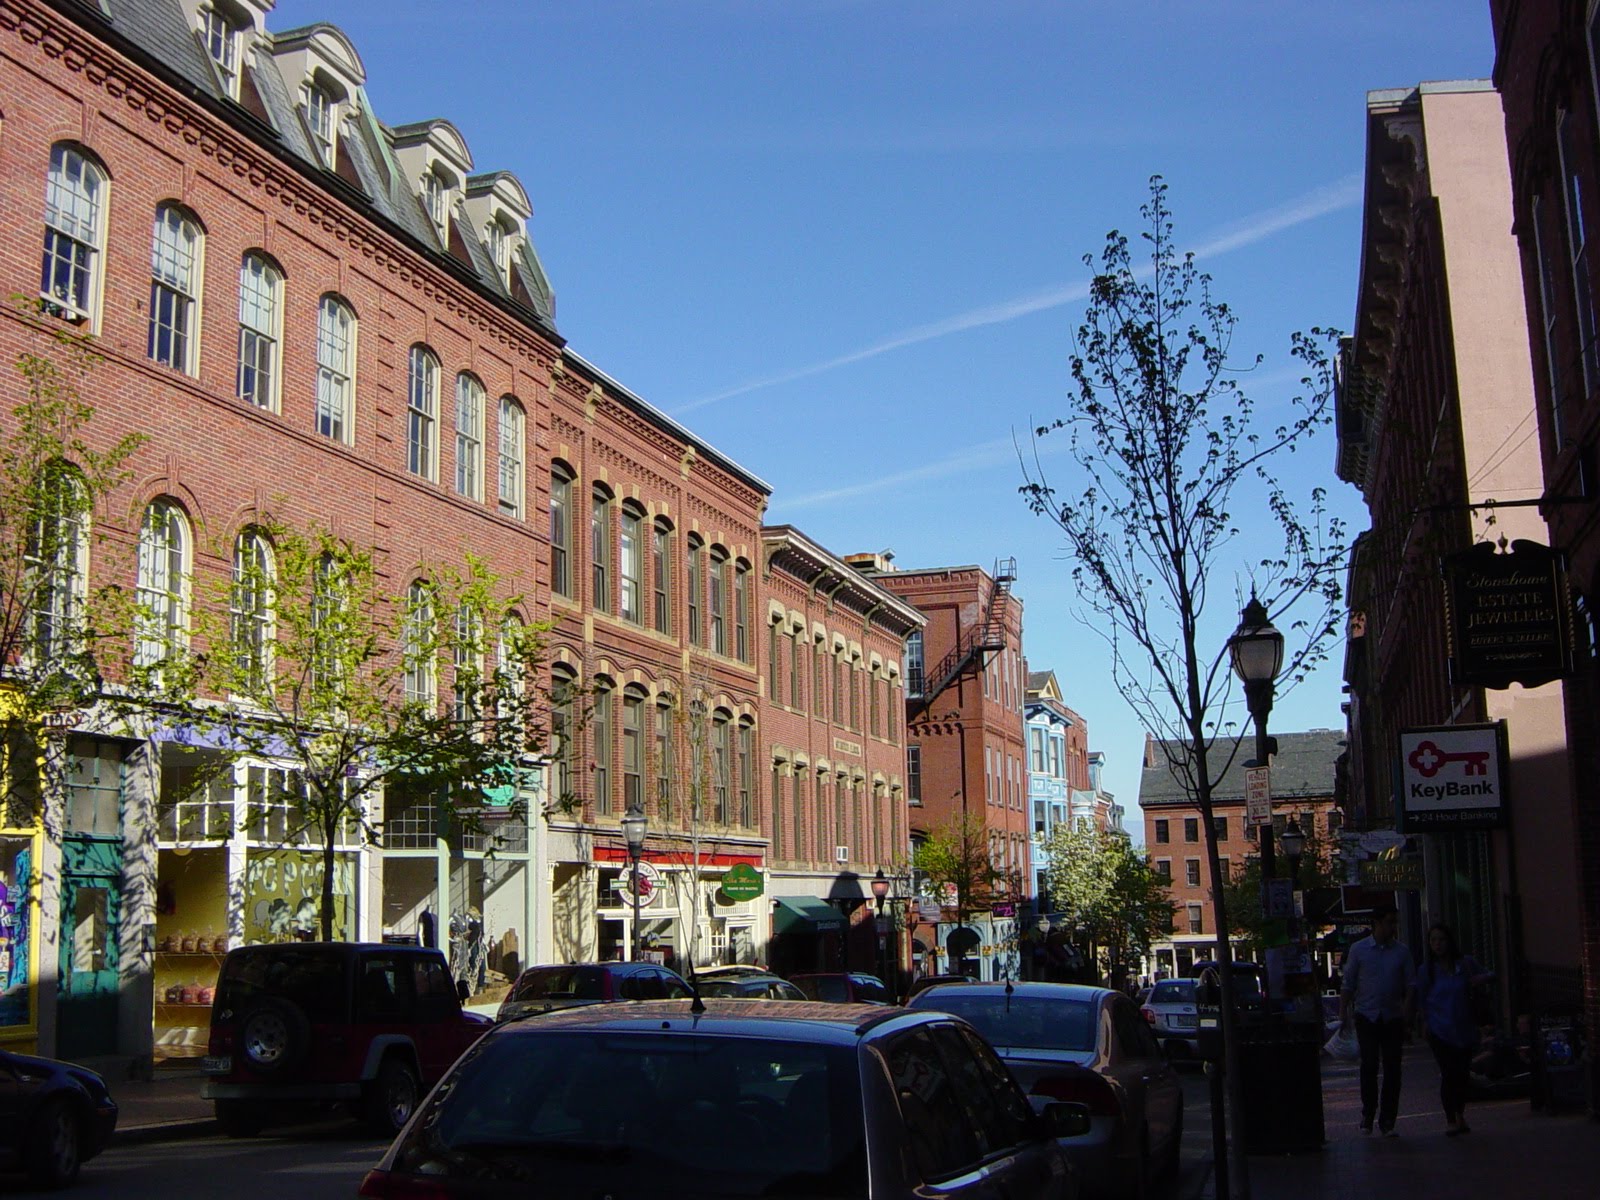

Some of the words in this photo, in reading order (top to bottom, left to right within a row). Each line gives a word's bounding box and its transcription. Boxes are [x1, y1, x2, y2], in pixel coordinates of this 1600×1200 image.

[1478, 591, 1543, 608] ESTATE
[1466, 608, 1555, 629] JEWELERS
[1252, 790, 1265, 800] ZONE
[1411, 781, 1494, 800] KeyBank
[1422, 814, 1434, 822] 24
[1436, 812, 1458, 821] Hour
[1460, 811, 1498, 821] Banking
